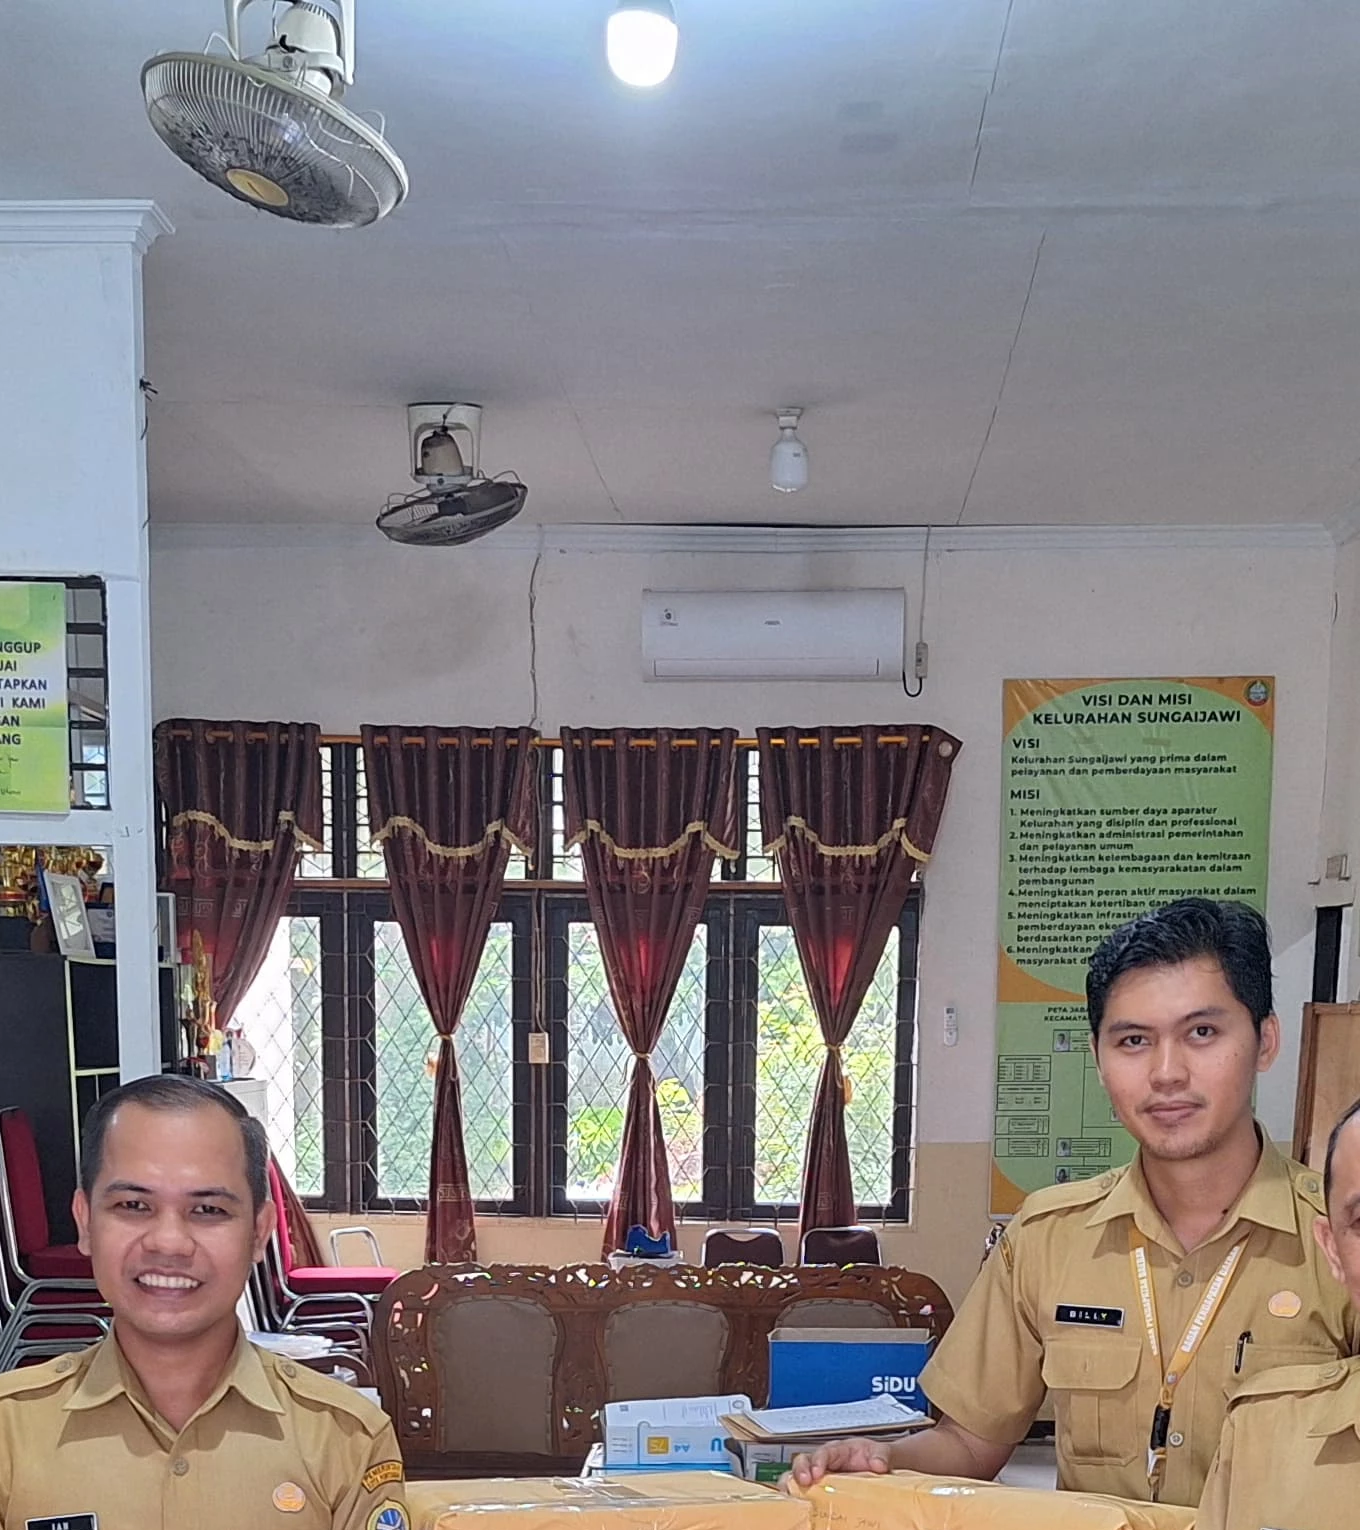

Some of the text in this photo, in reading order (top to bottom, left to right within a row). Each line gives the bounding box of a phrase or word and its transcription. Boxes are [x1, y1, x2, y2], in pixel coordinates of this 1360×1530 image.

[12, 697, 46, 710] KAMI
[1081, 693, 1192, 706] VISI DAN MISI
[1033, 711, 1241, 725] KELURAHAN SUNGAIJAWI
[1012, 738, 1040, 749] VISI
[1011, 753, 1227, 766] Kelurahan Sungaijawi yang prima dalam
[1011, 765, 1237, 778] pelayanan dan pemberdayaan masyarakat
[1010, 789, 1040, 800] MISI
[1020, 806, 1217, 818] Meningkatkan sumber daya aparatur
[1020, 817, 1237, 830] Kelurahan yang disiplin dan professional
[1020, 829, 1243, 841] Meningkatkan administrasi pemerintahan
[1019, 842, 1134, 853] dan pelayanan umum
[1019, 852, 1251, 864] Meningkatkan kelembagaan dan kemitraan
[1019, 863, 1242, 875] terhadap lembaga kemasyarakatan dalam
[1018, 877, 1095, 887] pembangunan
[1018, 886, 1256, 898] Meningkatkan peran aktif masyarakat dalam
[1018, 899, 1168, 909] menciptakan ketertiban dan
[1017, 911, 1093, 921] Meningkatkan
[1017, 923, 1096, 933] pemberdayaan
[1016, 934, 1083, 943] berdasarkan
[1016, 945, 1092, 955] Meningkatkan
[1016, 957, 1077, 967] masyarakat
[1069, 1310, 1108, 1321] BILLY
[872, 1376, 916, 1393] SiDU
